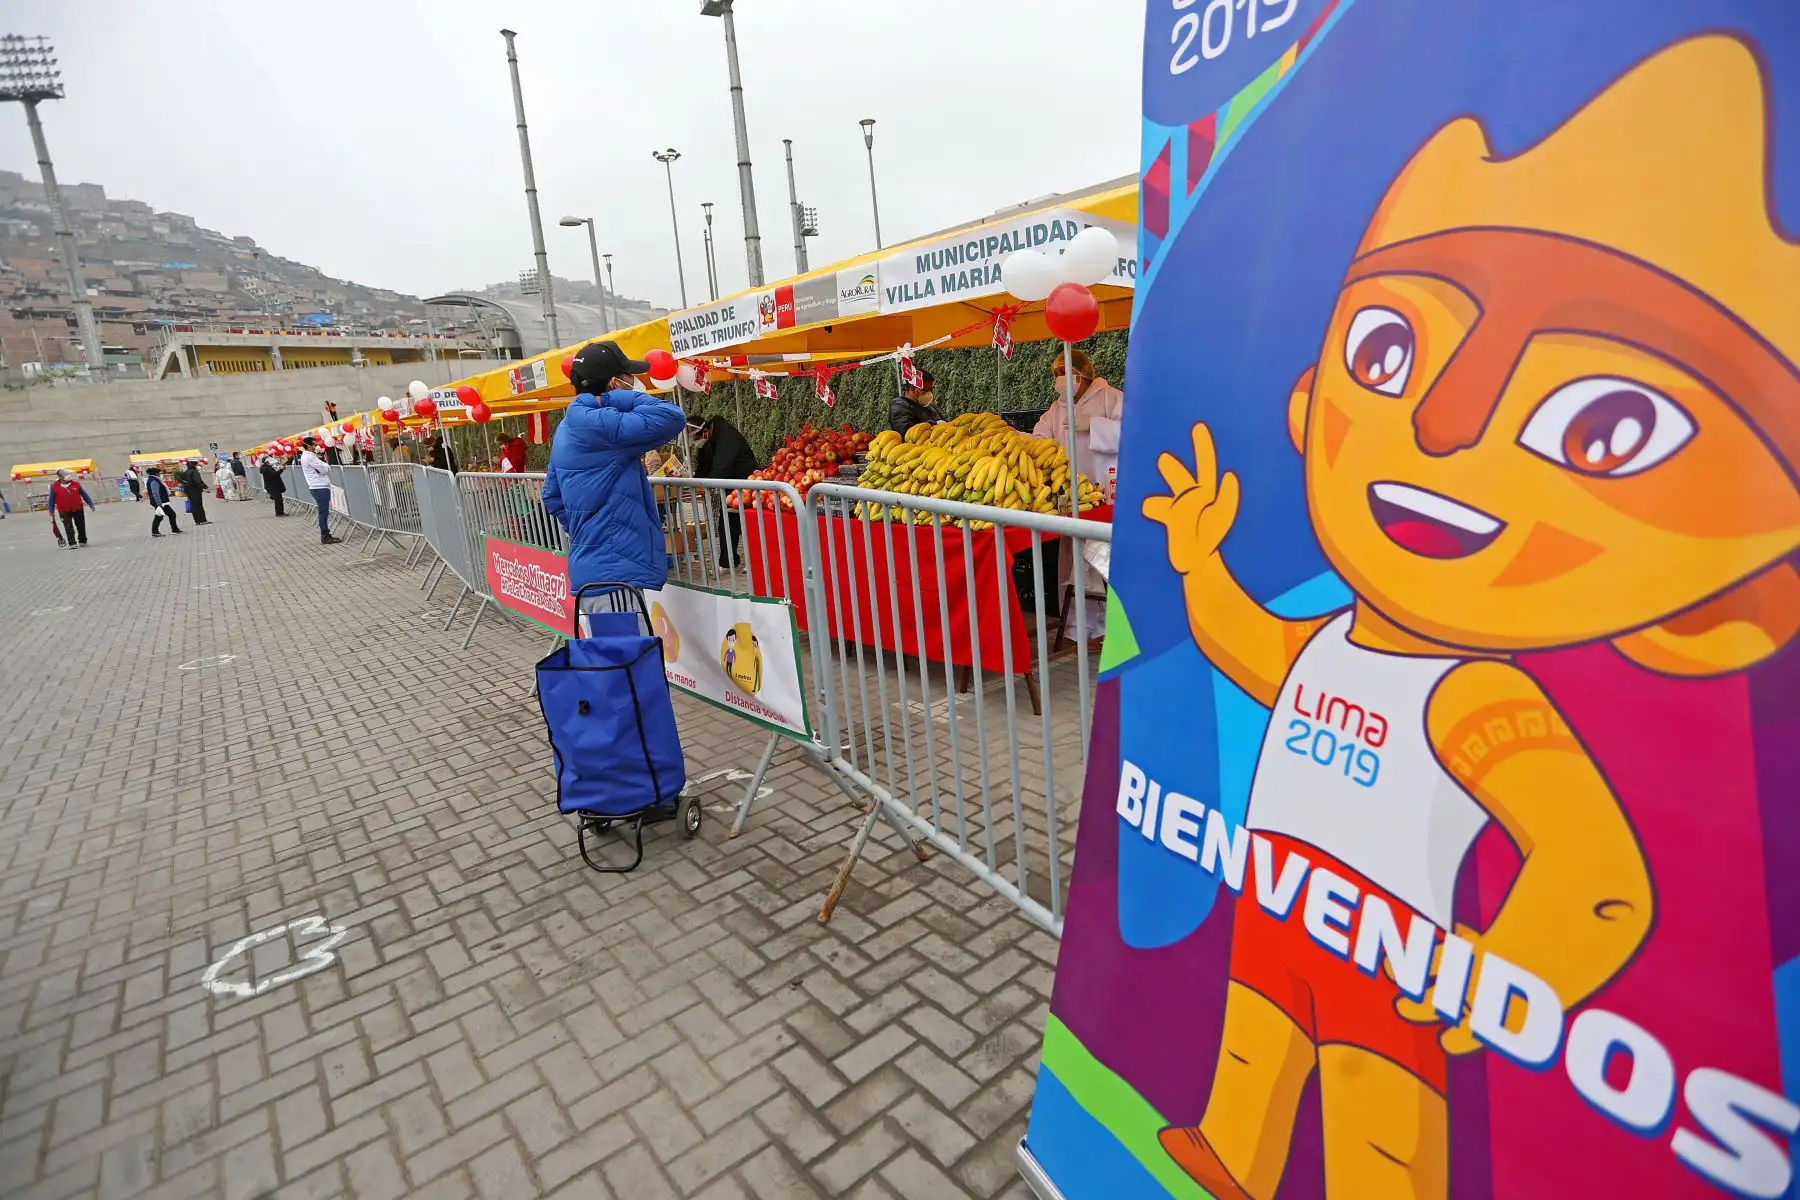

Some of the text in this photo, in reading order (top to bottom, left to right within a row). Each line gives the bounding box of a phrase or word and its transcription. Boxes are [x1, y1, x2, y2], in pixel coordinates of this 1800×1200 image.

[916, 219, 1078, 274] MUNICIPALIDAD
[886, 259, 1002, 305] VILLA MARÍA
[720, 305, 736, 321] DE
[778, 301, 793, 313] PERÚ
[691, 332, 709, 348] DEL
[711, 320, 756, 344] TRIUNFO
[528, 563, 567, 601] Minagri
[674, 672, 697, 689] manos
[725, 690, 761, 714] Distancia
[1285, 719, 1380, 787] 2019
[1116, 759, 1800, 1199] BIENVENIDOS
